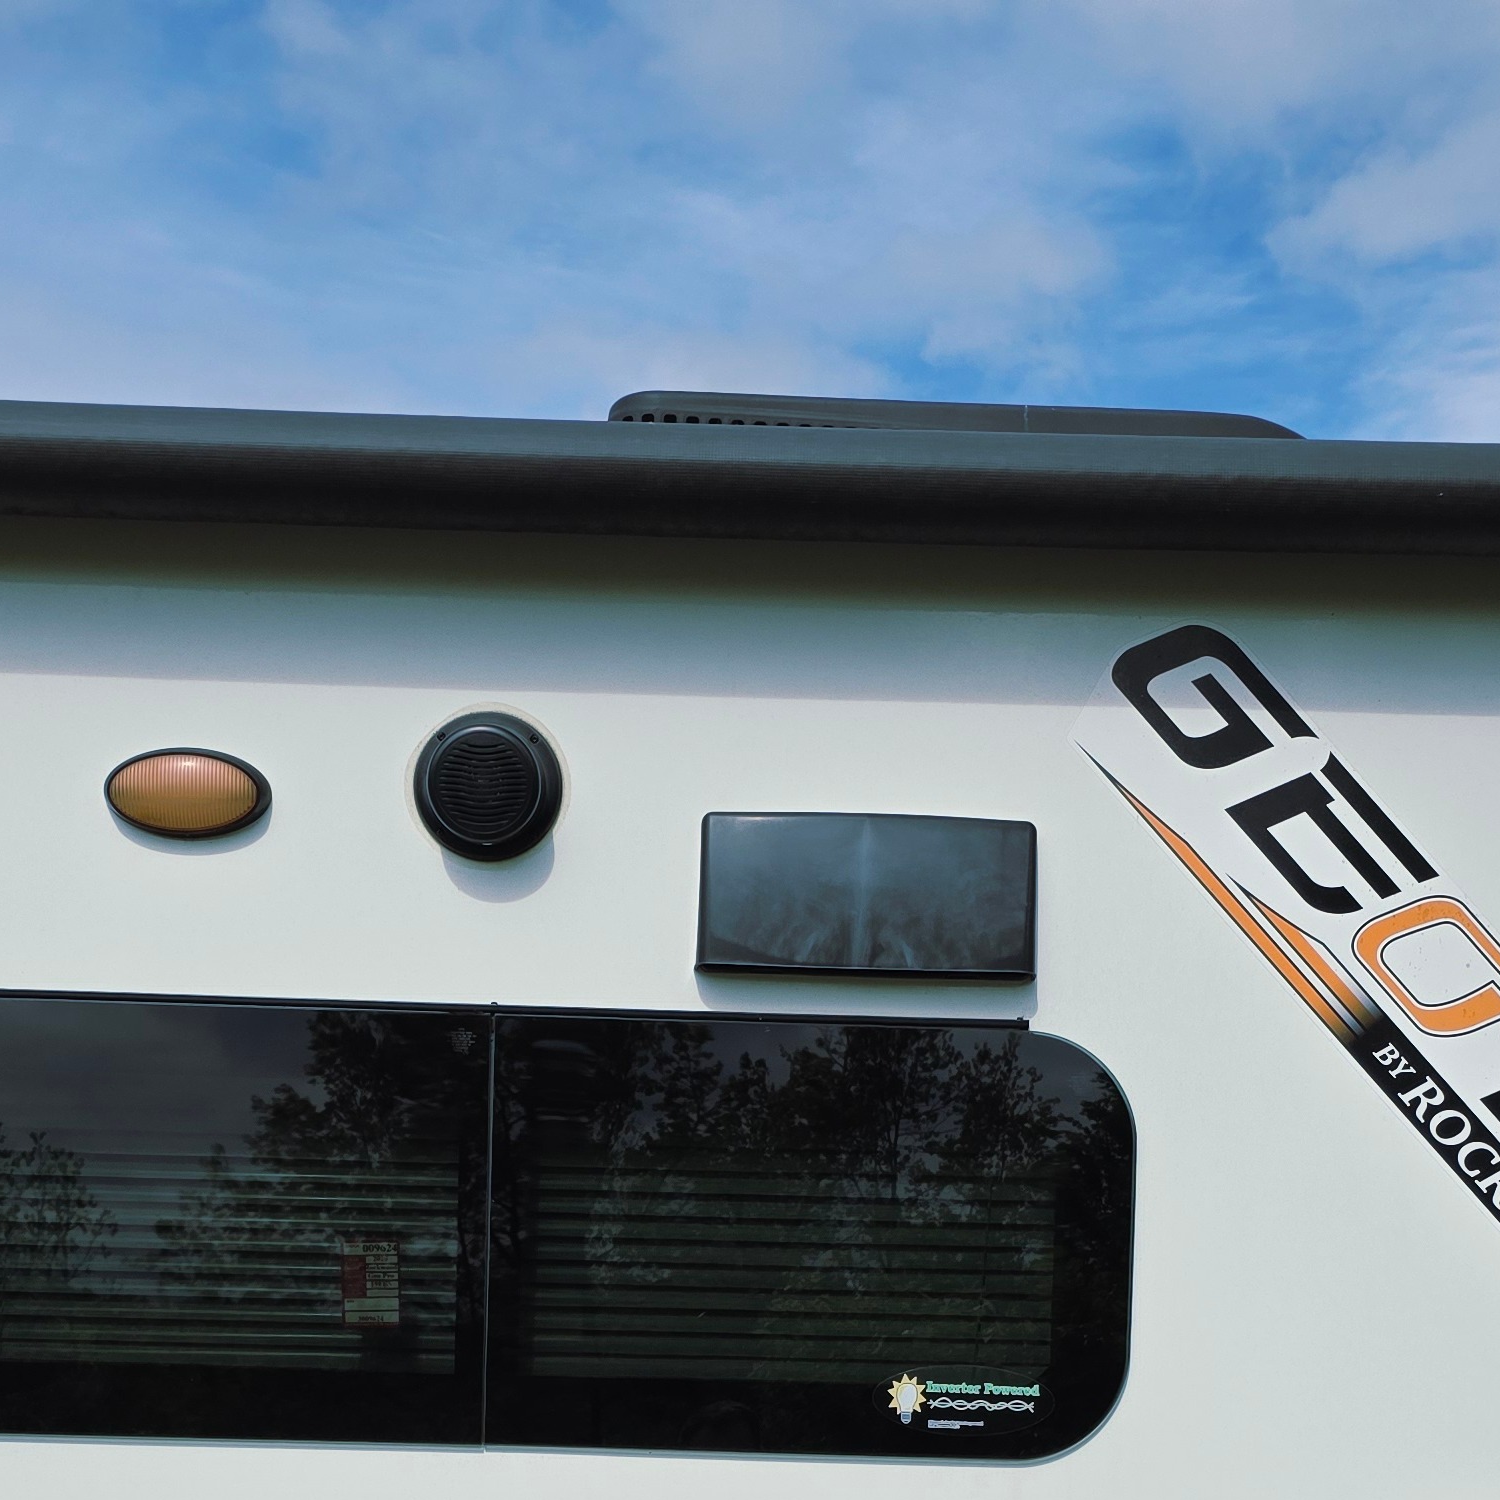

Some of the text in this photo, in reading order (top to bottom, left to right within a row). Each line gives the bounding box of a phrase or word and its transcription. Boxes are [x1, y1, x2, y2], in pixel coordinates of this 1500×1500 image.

[1373, 1042, 1417, 1082] BY
[926, 1381, 1040, 1397] Inverter Powered
